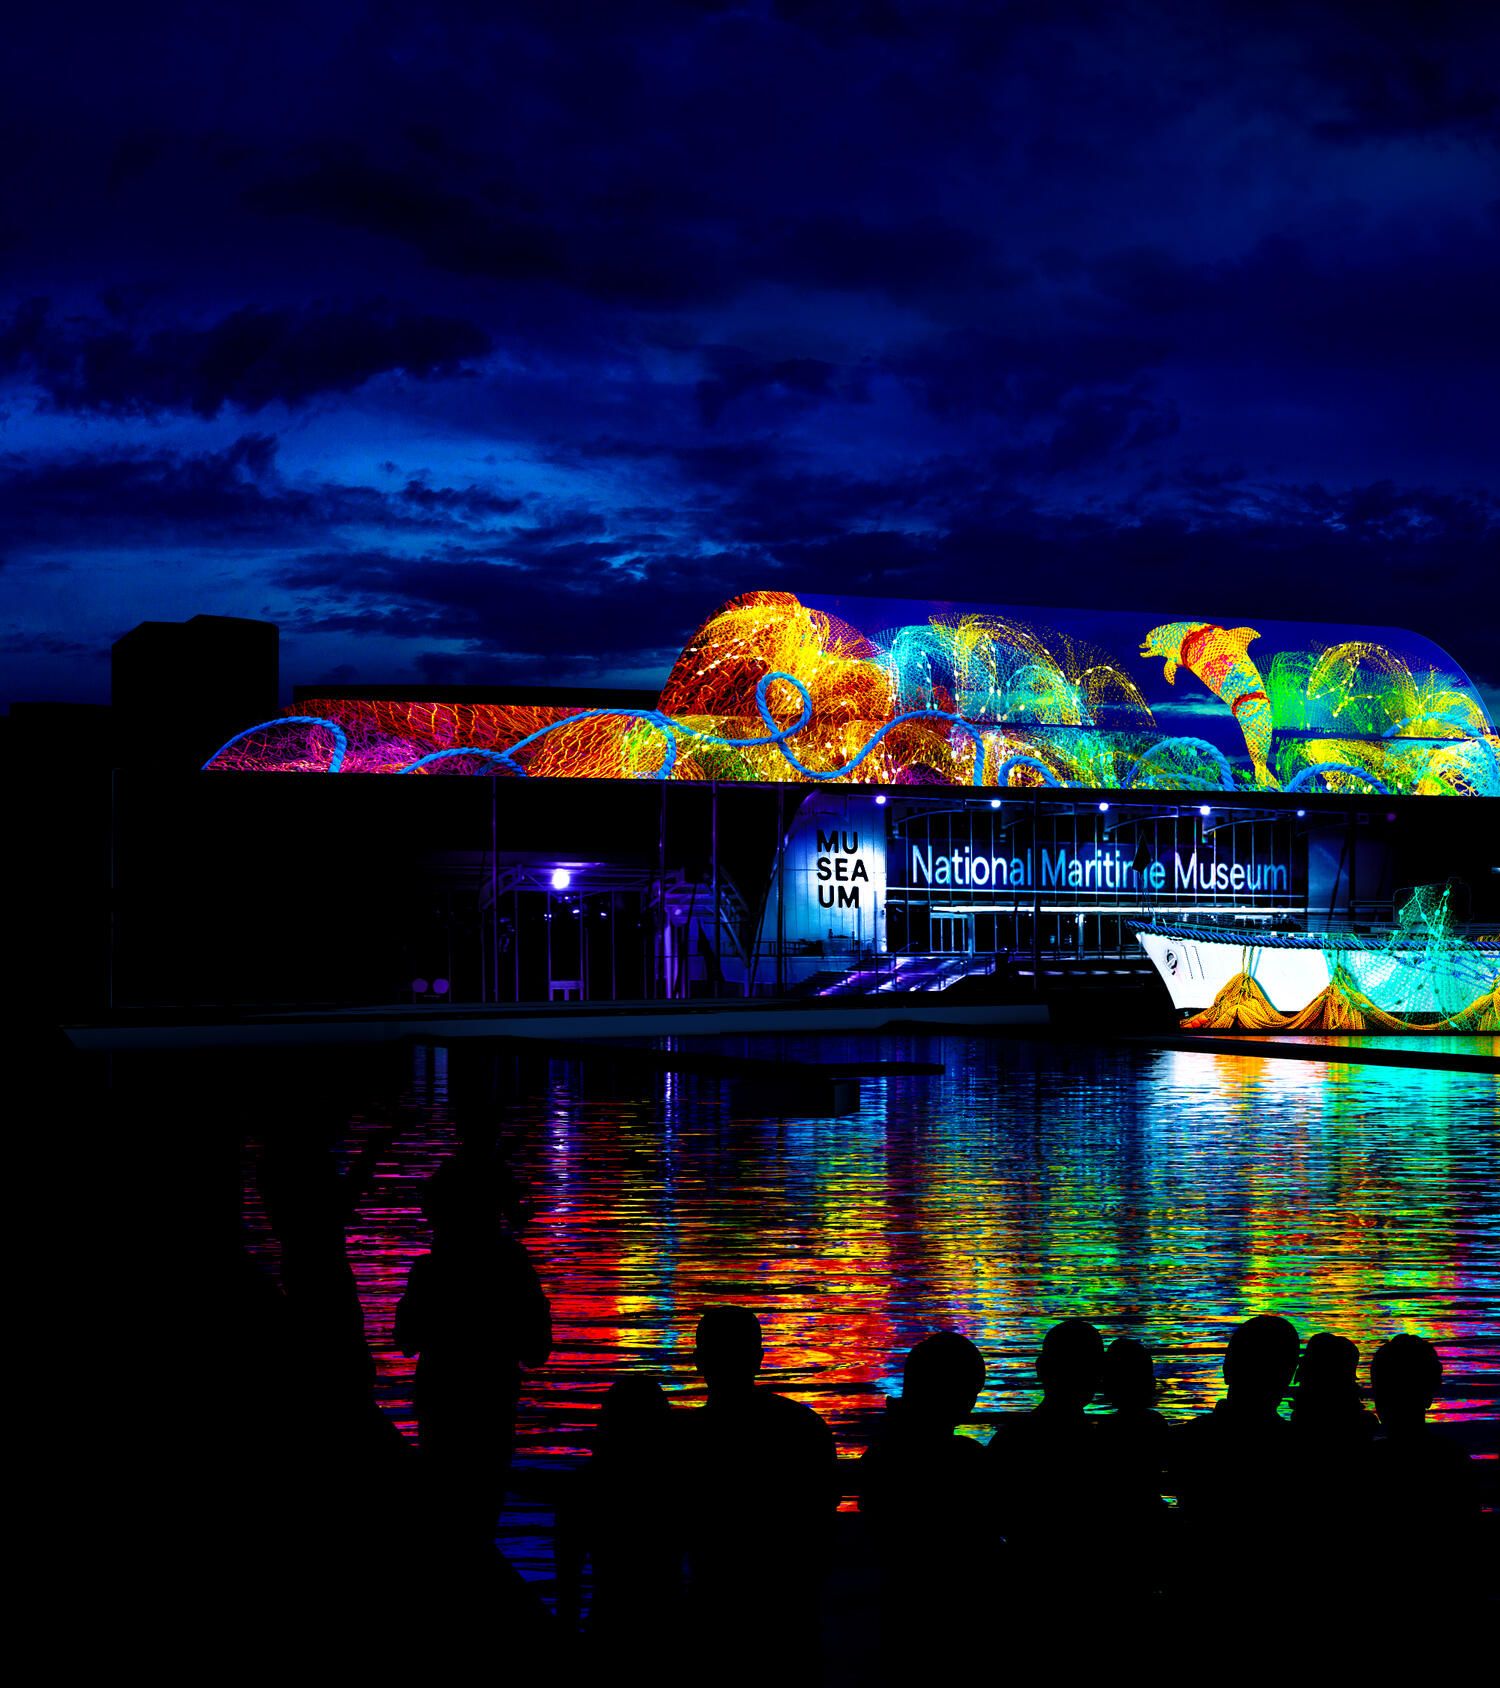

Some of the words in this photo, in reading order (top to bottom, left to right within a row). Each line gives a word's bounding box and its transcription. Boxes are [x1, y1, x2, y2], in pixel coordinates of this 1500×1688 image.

[816, 829, 859, 854] MU
[816, 856, 869, 882] SEA
[912, 844, 1032, 886] National
[1174, 851, 1287, 891] Museum
[818, 884, 860, 909] UM
